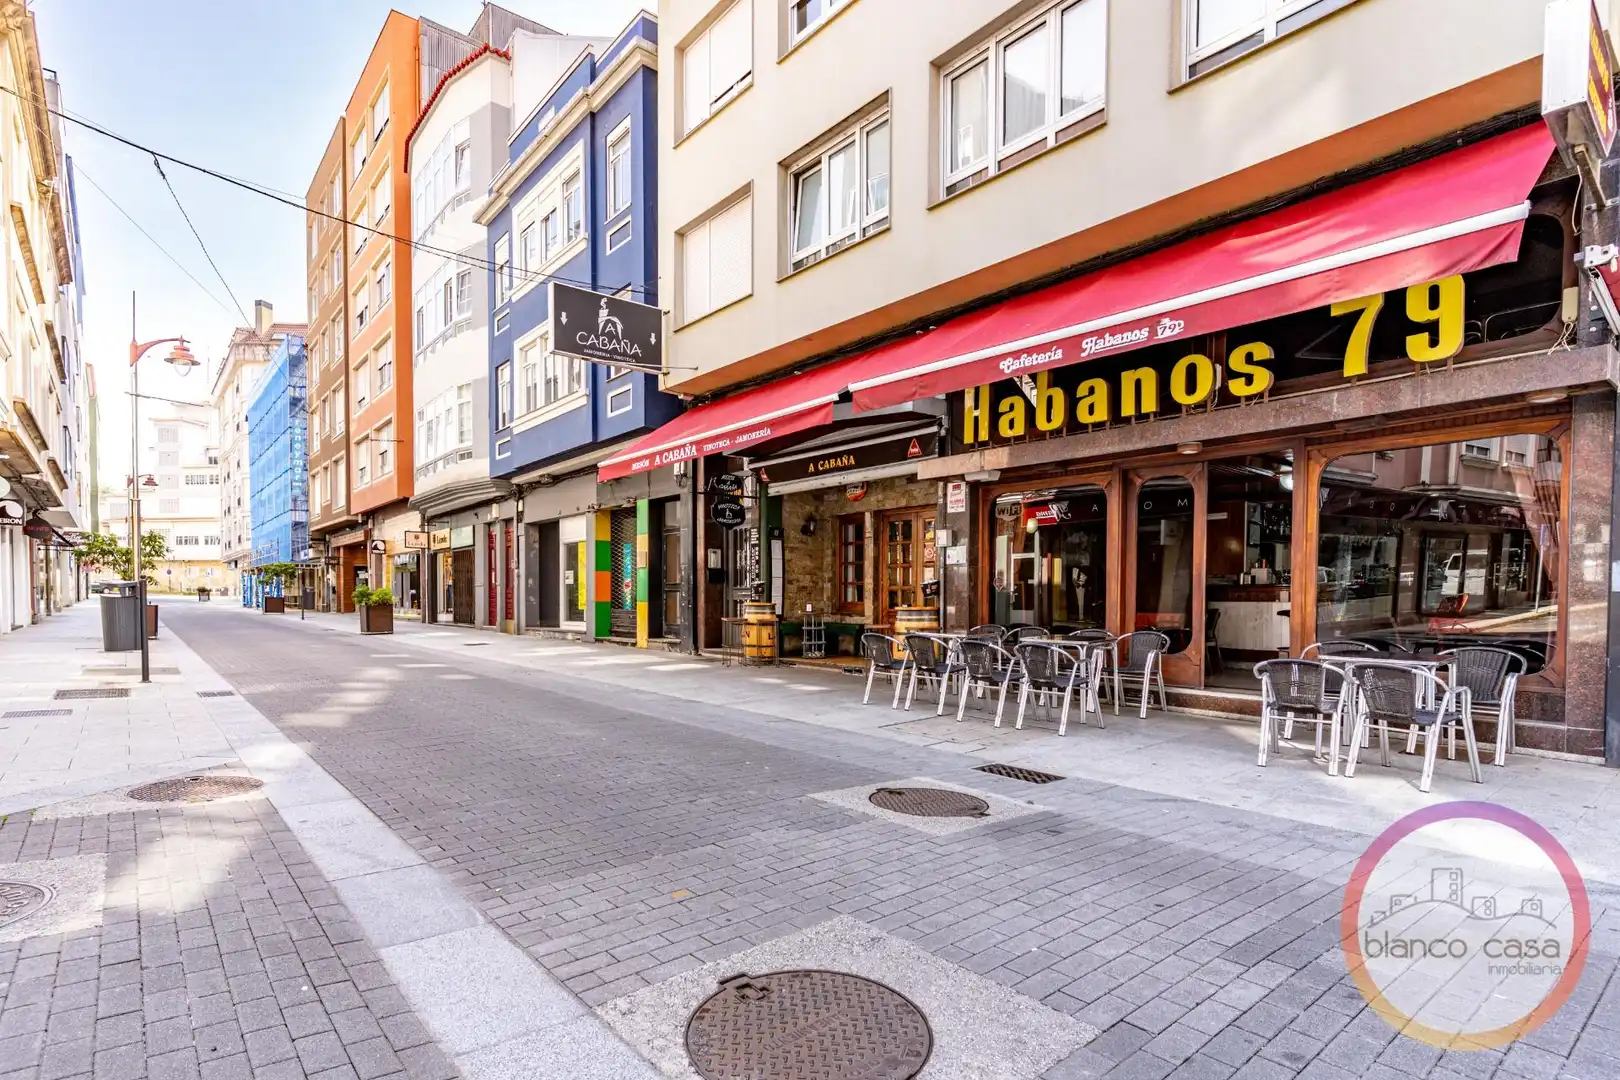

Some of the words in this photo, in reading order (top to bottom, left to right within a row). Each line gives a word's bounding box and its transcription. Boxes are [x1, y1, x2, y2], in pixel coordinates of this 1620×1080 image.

[576, 331, 642, 357] CABAÑA
[604, 322, 616, 335] A
[963, 341, 1275, 444] Habanos
[1330, 274, 1465, 378] 79
[999, 346, 1063, 374] Cafetería
[1081, 325, 1150, 357] Habanos
[654, 454, 661, 466] A
[662, 443, 697, 463] CABAÑA
[702, 438, 730, 452] VINOTECA
[734, 426, 771, 444] JAMONERÍA
[808, 462, 815, 473] A
[817, 454, 856, 471] CABAÑA
